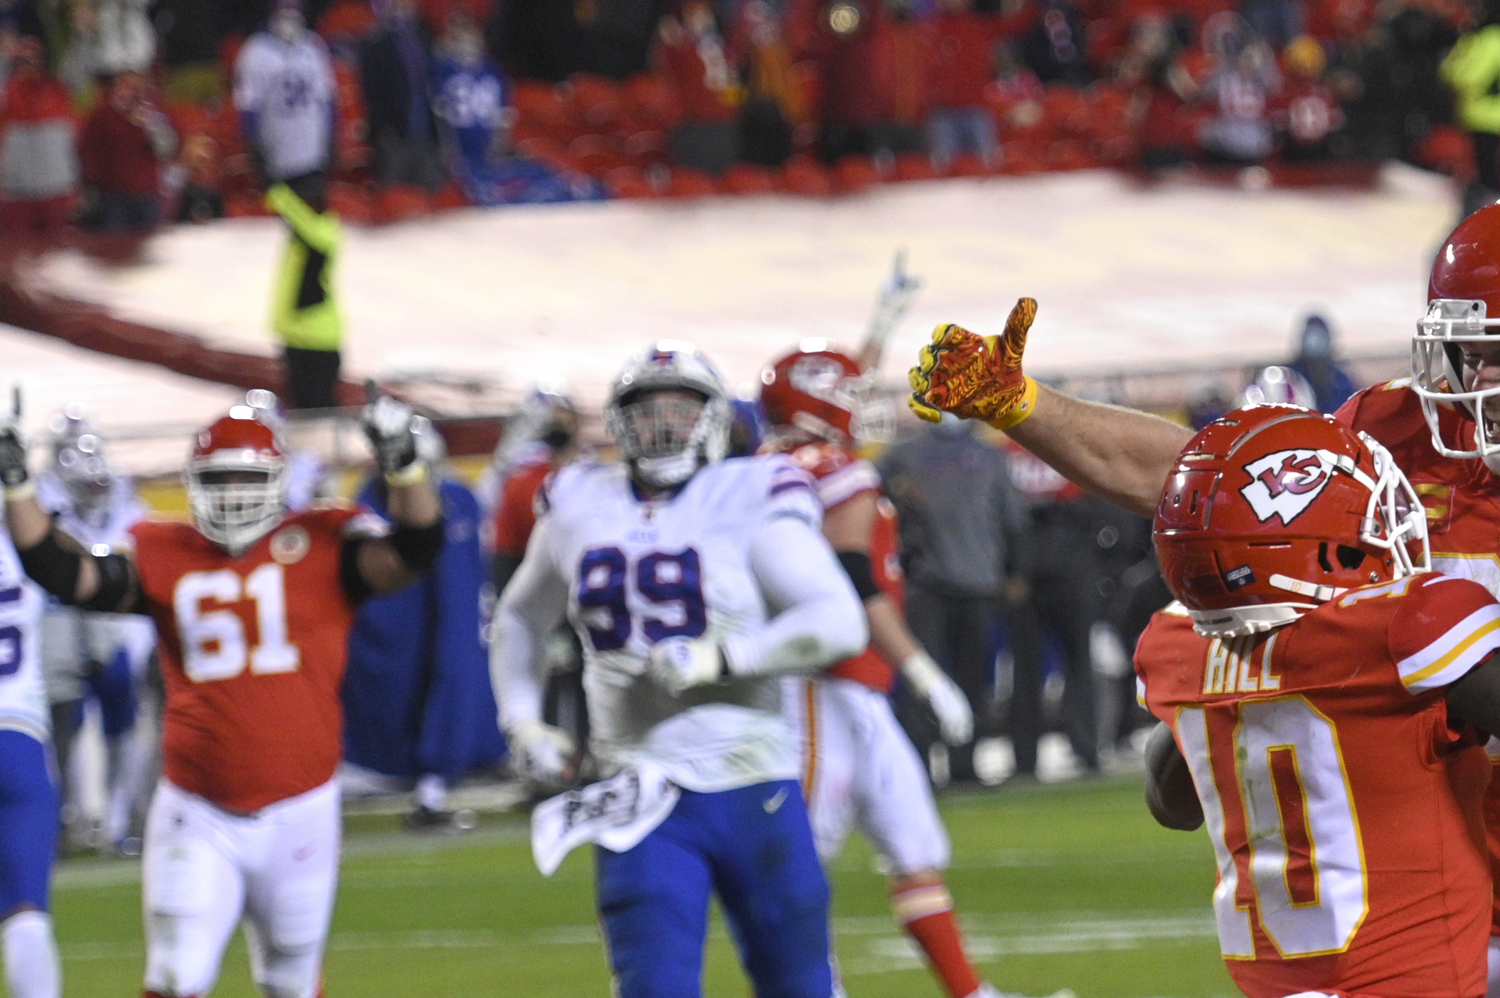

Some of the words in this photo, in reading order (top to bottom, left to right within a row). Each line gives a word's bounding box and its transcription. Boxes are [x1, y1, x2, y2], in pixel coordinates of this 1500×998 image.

[1257, 454, 1327, 499] KC
[174, 563, 299, 682] 61
[577, 547, 707, 651] 99
[1203, 632, 1281, 694] HILL
[1175, 694, 1369, 961] 10
